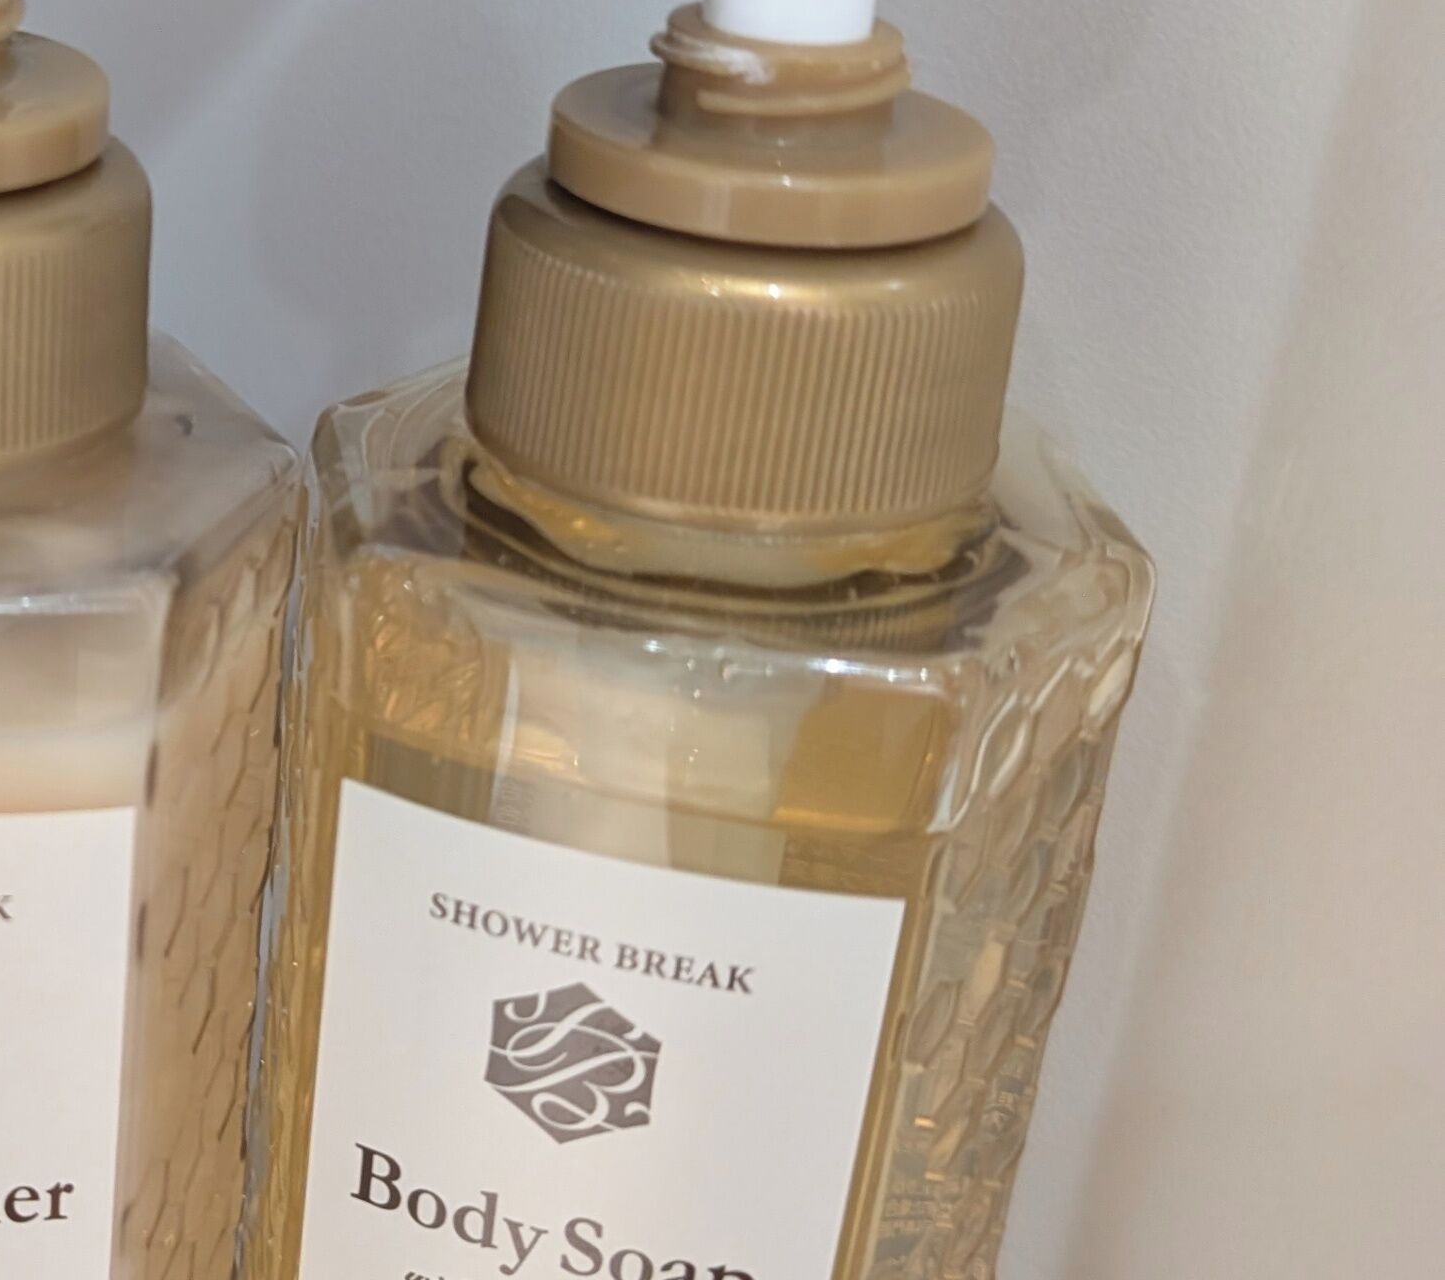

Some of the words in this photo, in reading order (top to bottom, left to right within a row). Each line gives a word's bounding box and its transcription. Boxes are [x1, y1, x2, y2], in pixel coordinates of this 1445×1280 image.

[428, 891, 602, 965] SHOWER
[613, 942, 755, 996] BREAK
[348, 1141, 550, 1278] Body
